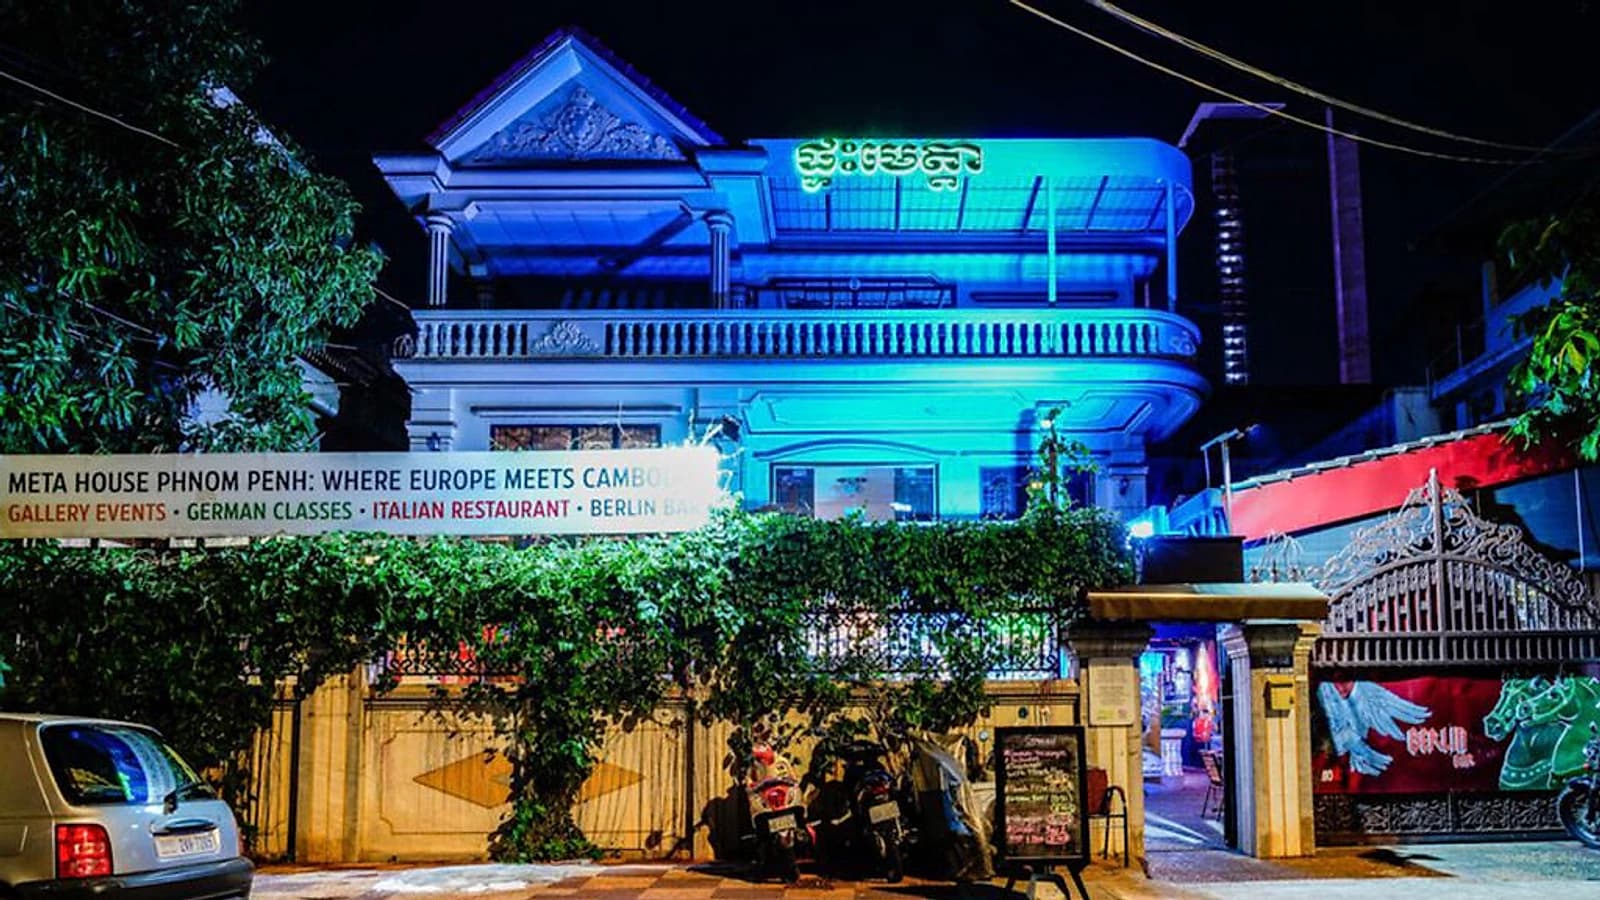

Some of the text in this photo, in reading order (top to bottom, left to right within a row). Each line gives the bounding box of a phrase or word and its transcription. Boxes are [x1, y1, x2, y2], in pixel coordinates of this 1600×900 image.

[8, 472, 68, 493] META
[75, 471, 149, 493] HOUSE
[156, 470, 239, 492] PHNOM
[247, 470, 315, 491] PENH:
[322, 469, 402, 491] WHERE
[410, 469, 497, 491] EUROPE
[504, 468, 576, 490] MEETS
[8, 503, 89, 523] GALLERY
[95, 503, 167, 521] EVENTS
[187, 501, 267, 520] GERMAN
[273, 501, 353, 520] CLASSES
[372, 500, 445, 519] ITALIAN
[451, 499, 569, 519] RESTAURANT
[590, 498, 656, 517] BERLIN
[1406, 726, 1468, 755] BERLIN
